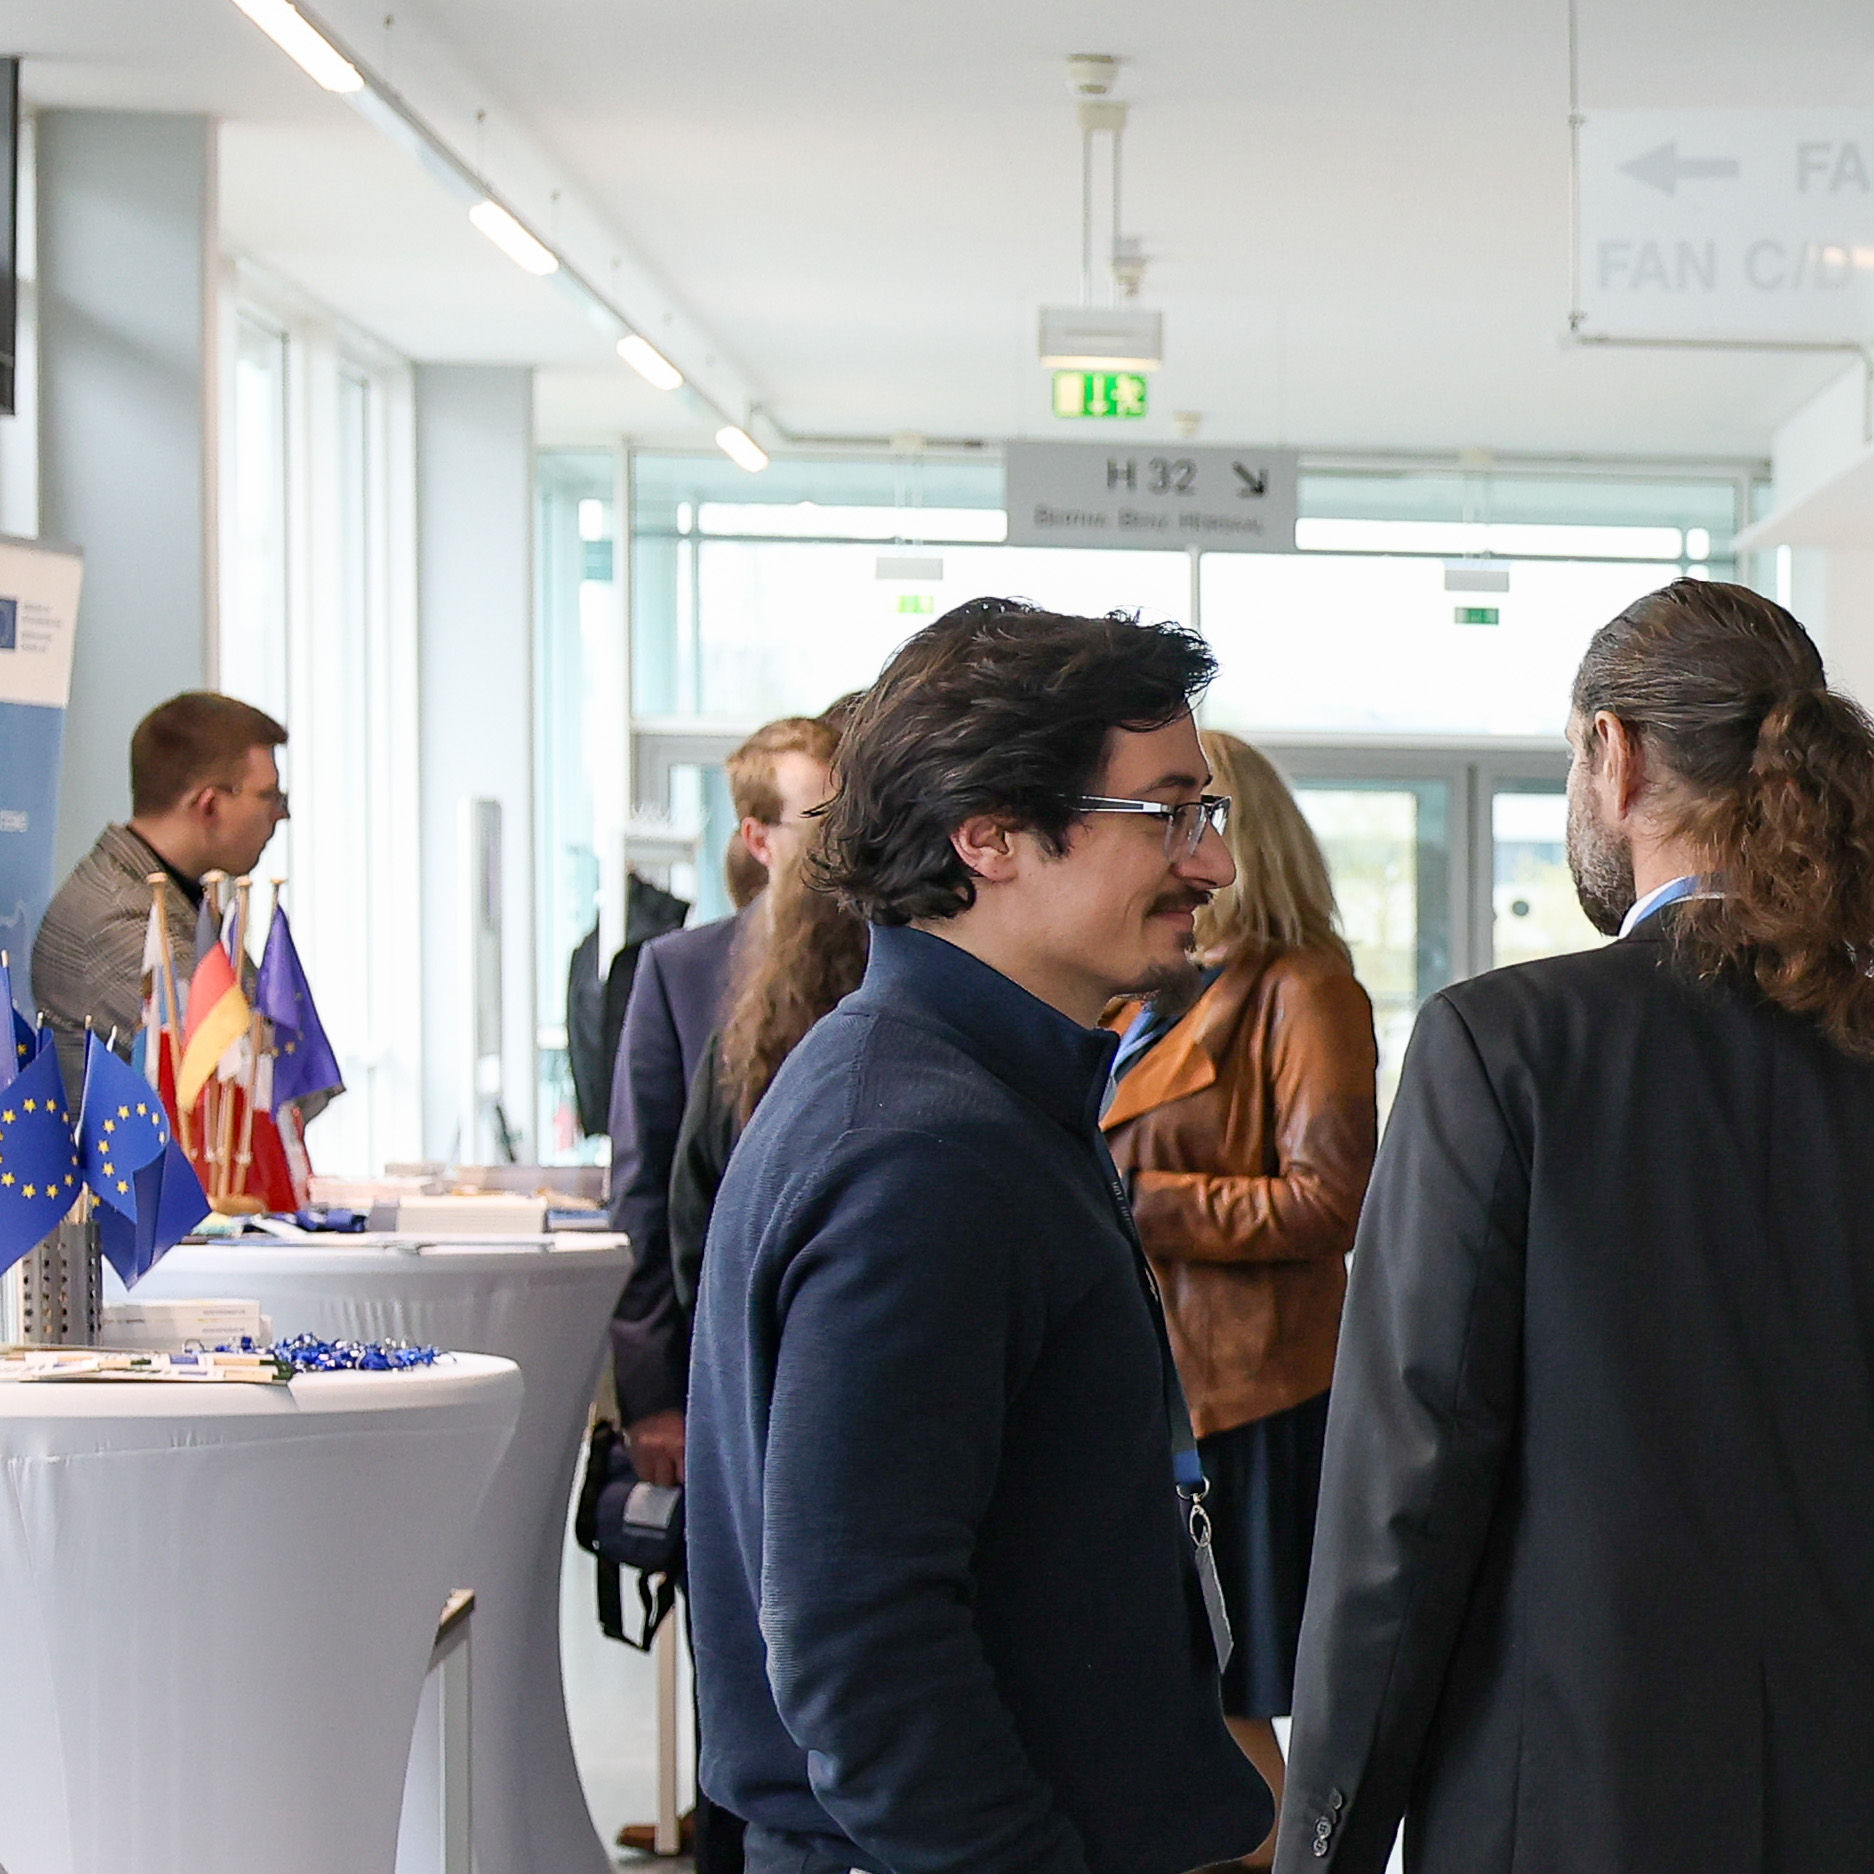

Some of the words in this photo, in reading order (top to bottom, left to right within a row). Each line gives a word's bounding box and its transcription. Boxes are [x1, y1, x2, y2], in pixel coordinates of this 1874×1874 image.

[1597, 239, 1717, 292] FAN
[1743, 236, 1855, 293] C/D
[1106, 457, 1137, 491] H
[1148, 456, 1198, 497] 32
